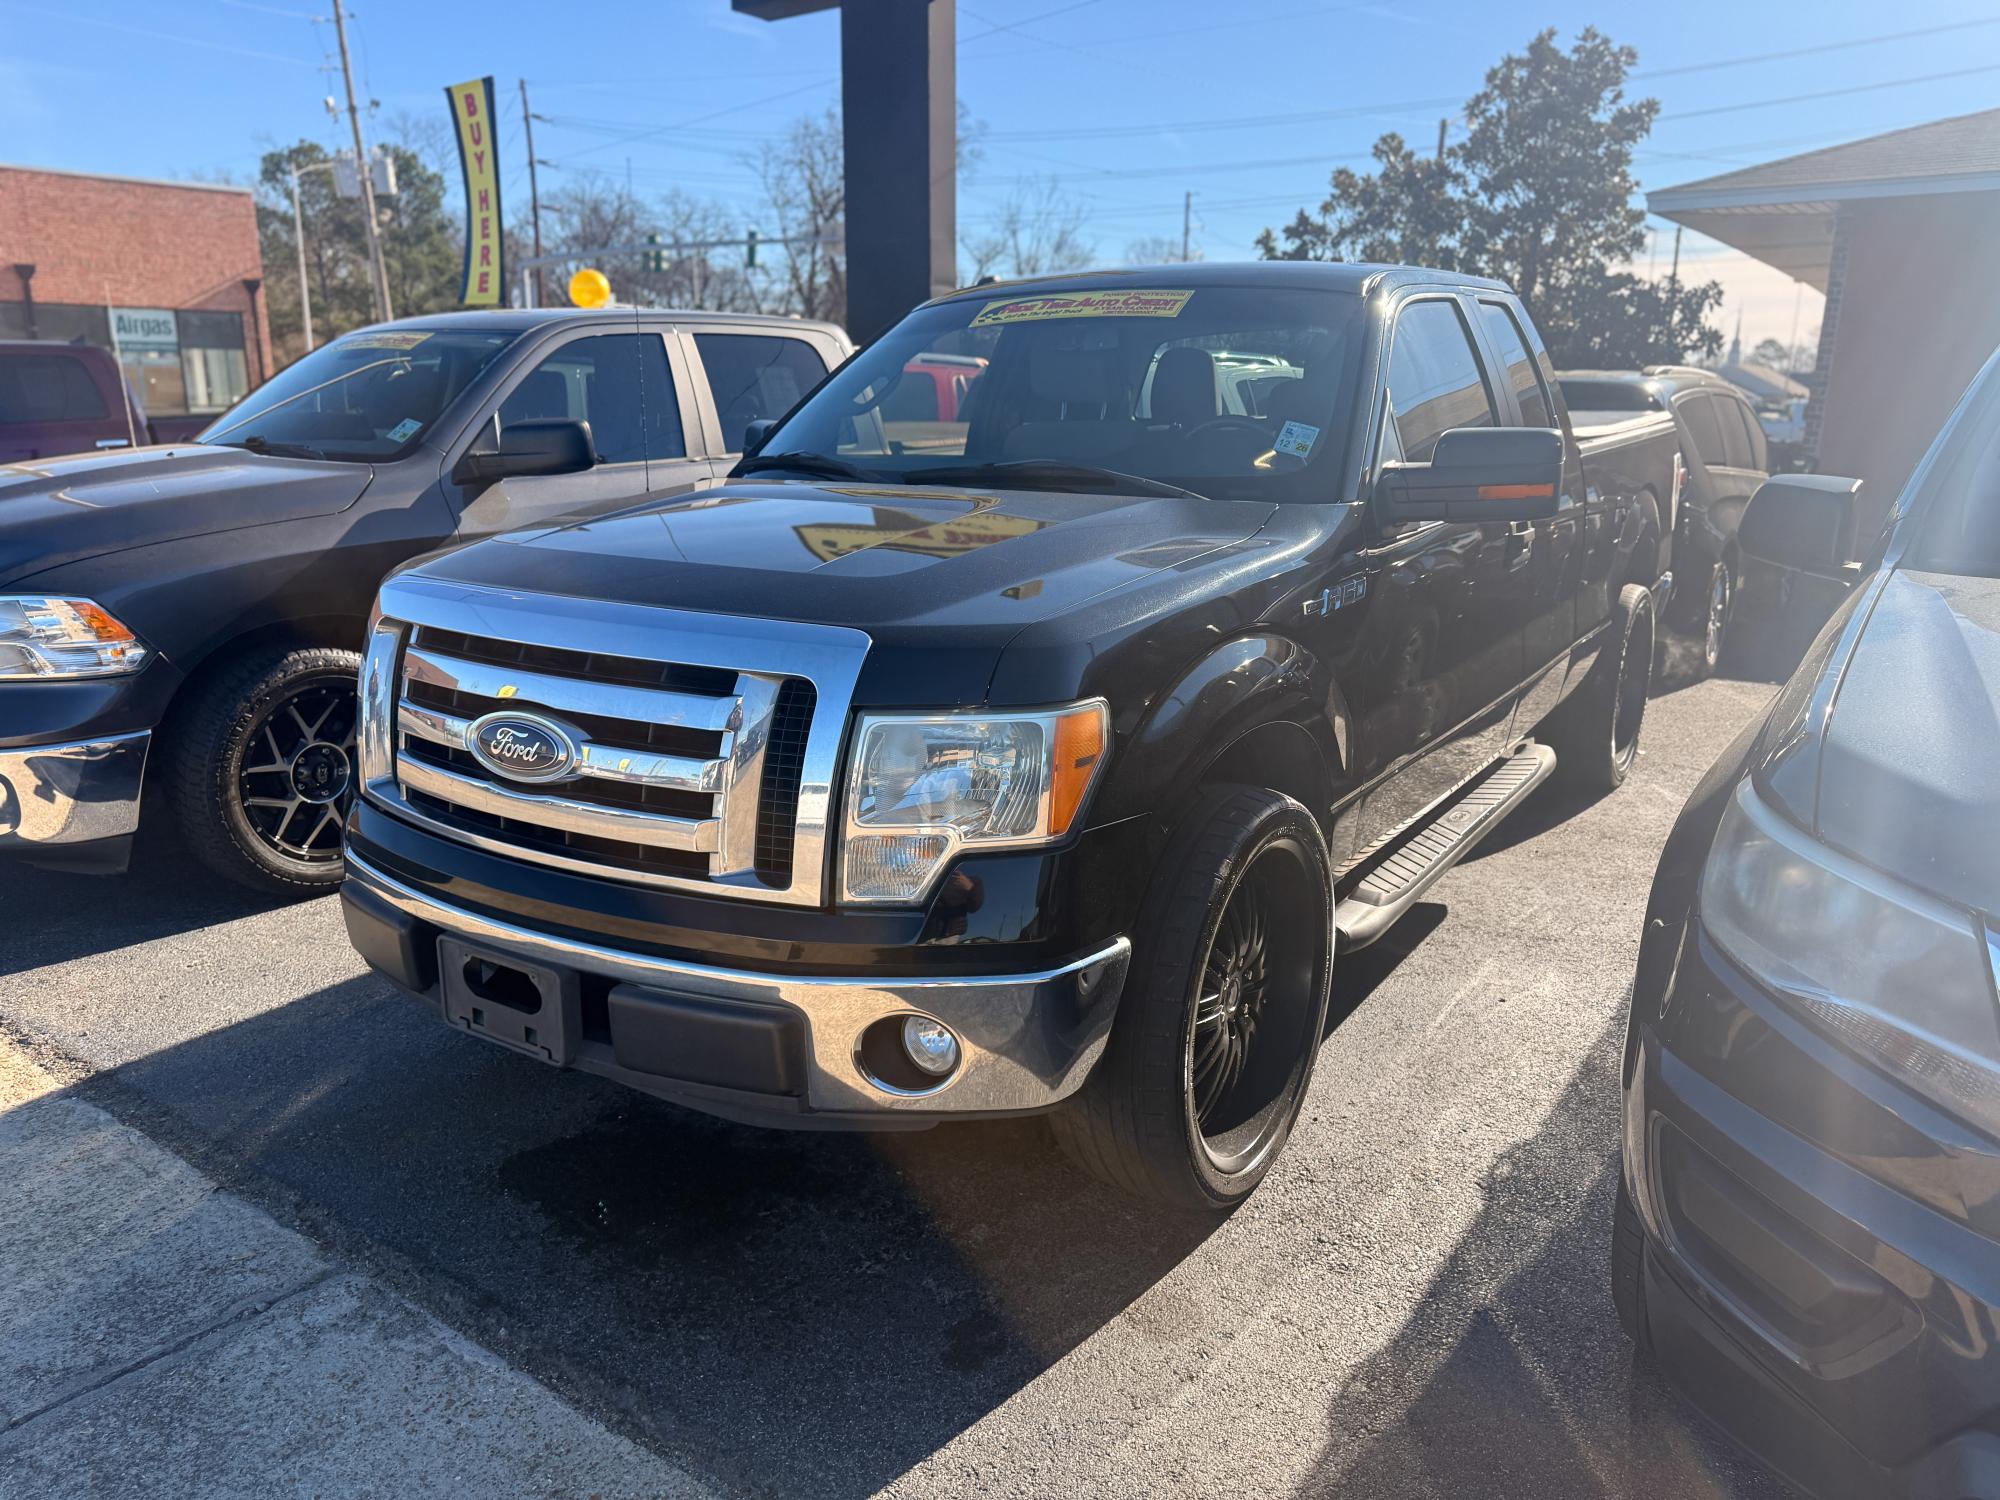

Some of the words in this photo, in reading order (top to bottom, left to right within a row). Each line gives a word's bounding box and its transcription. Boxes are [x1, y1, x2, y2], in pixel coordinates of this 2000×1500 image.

[463, 93, 484, 175] BUY
[476, 188, 491, 294] HERE
[1075, 297, 1121, 308] AUTO
[1122, 296, 1183, 308] CREDIT
[116, 315, 173, 337] Airgas
[491, 727, 540, 762] Ford
